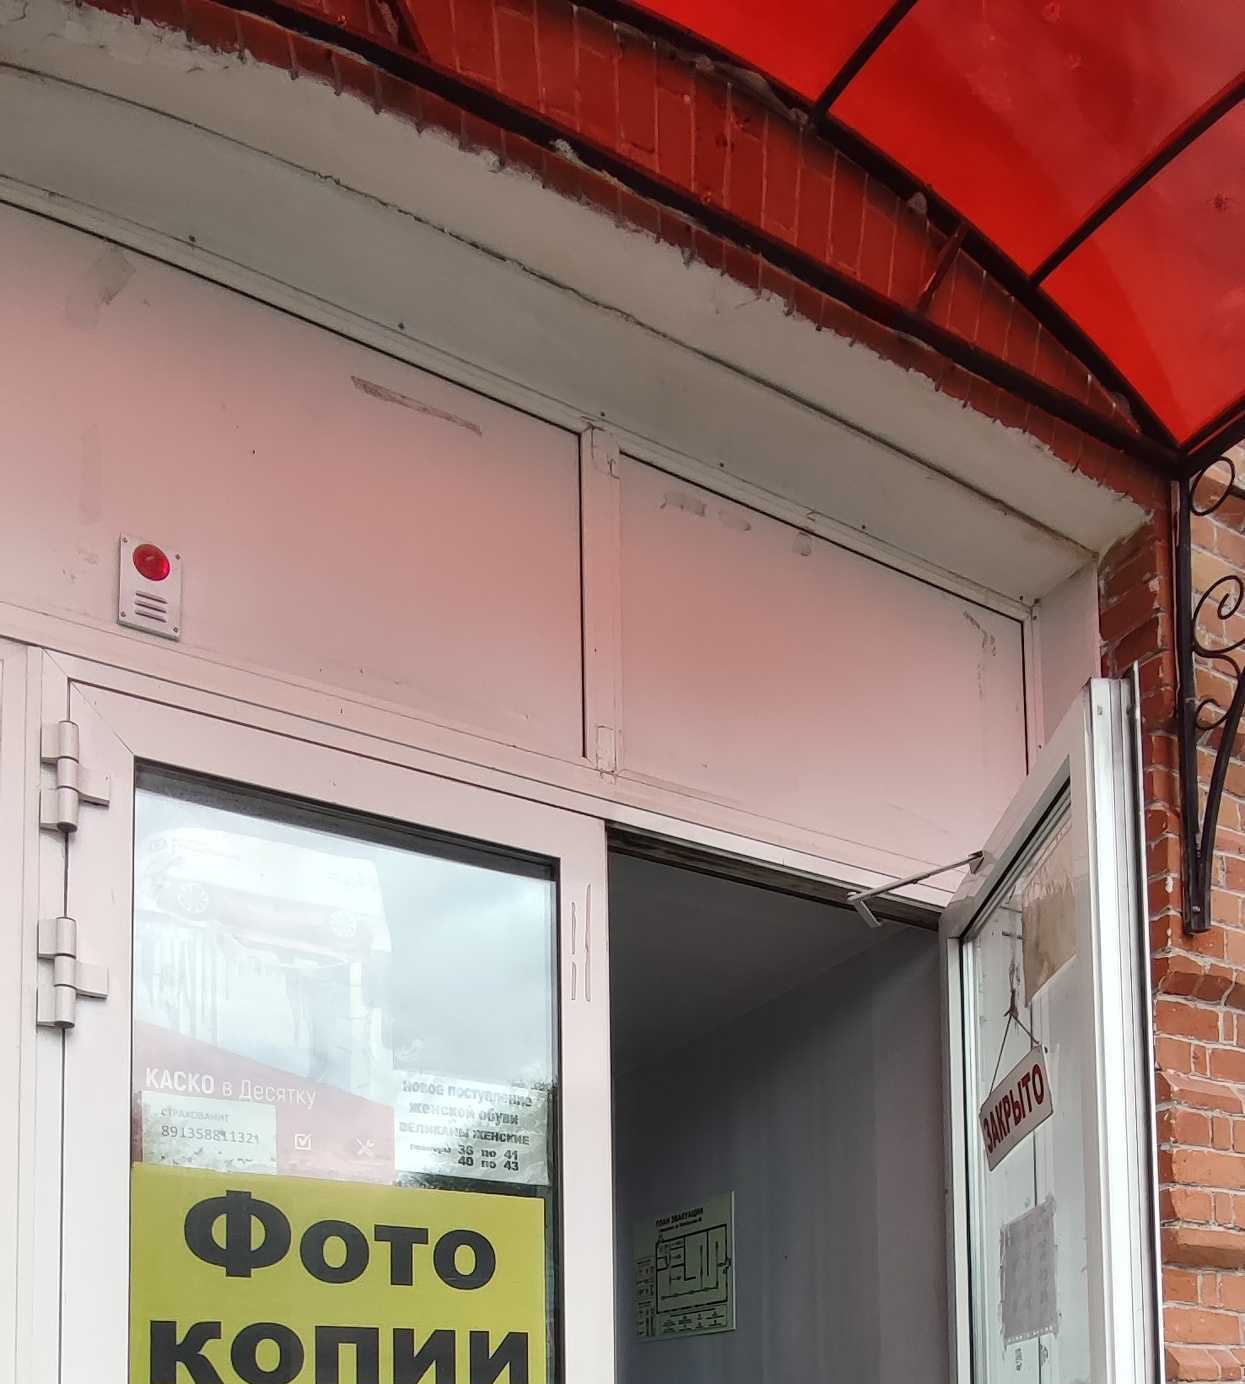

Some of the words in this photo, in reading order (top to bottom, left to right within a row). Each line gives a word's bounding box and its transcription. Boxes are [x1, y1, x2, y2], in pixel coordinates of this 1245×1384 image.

[146, 1068, 215, 1095] КАСКО
[222, 1081, 233, 1097] в
[239, 1080, 318, 1110] Десятку
[984, 1064, 1044, 1153] ЗАКРЫТО
[479, 1109, 519, 1126] обуви
[472, 1129, 530, 1146] ЖЕНСКИЕ
[458, 1144, 474, 1156] 36
[481, 1149, 497, 1159] по
[504, 1150, 518, 1160] 41
[458, 1156, 474, 1167] 40
[481, 1160, 497, 1169] по
[504, 1161, 519, 1172] 43
[184, 1190, 496, 1290] Фото
